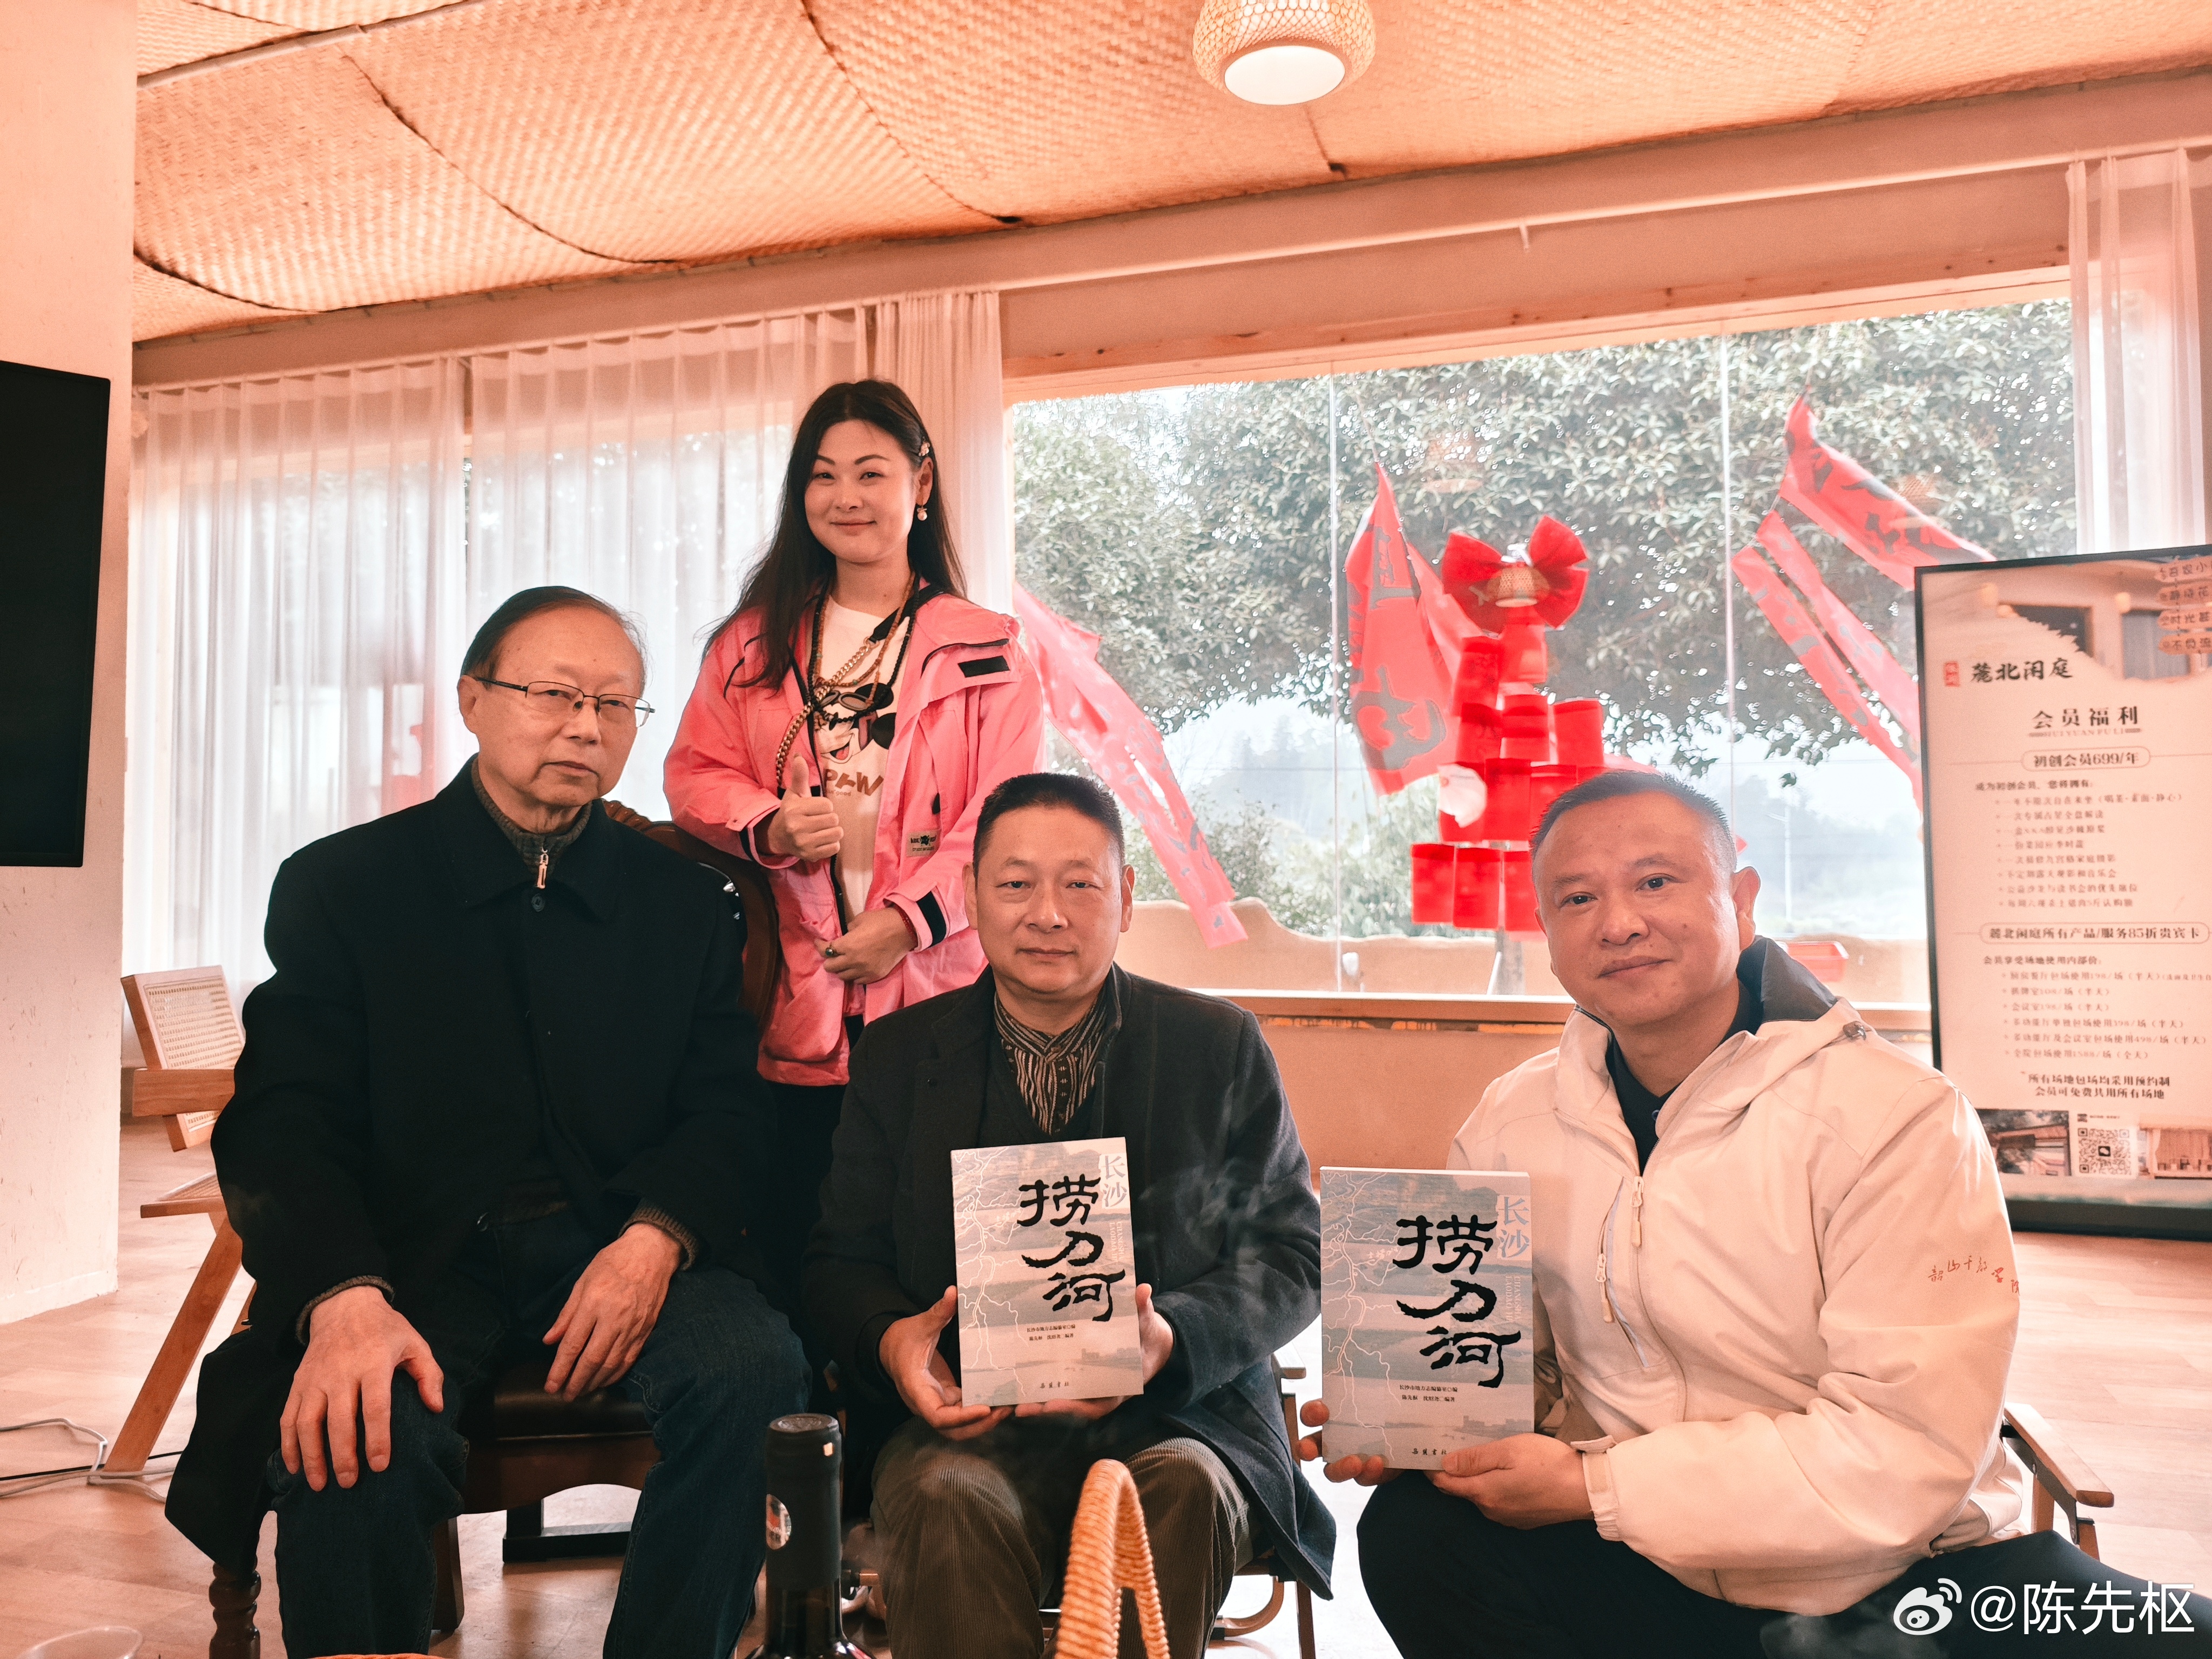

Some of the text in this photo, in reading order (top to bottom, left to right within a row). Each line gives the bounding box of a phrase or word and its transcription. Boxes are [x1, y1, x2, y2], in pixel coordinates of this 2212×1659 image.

[2032, 706, 2138, 729] 会员福利
[2034, 752, 2139, 767] 初创会员699/年
[1101, 1155, 1128, 1208] 长沙
[1017, 1173, 1126, 1322] 捞刀河
[1498, 1196, 1530, 1259] 长沙
[1392, 1214, 1521, 1388] 捞刀河
